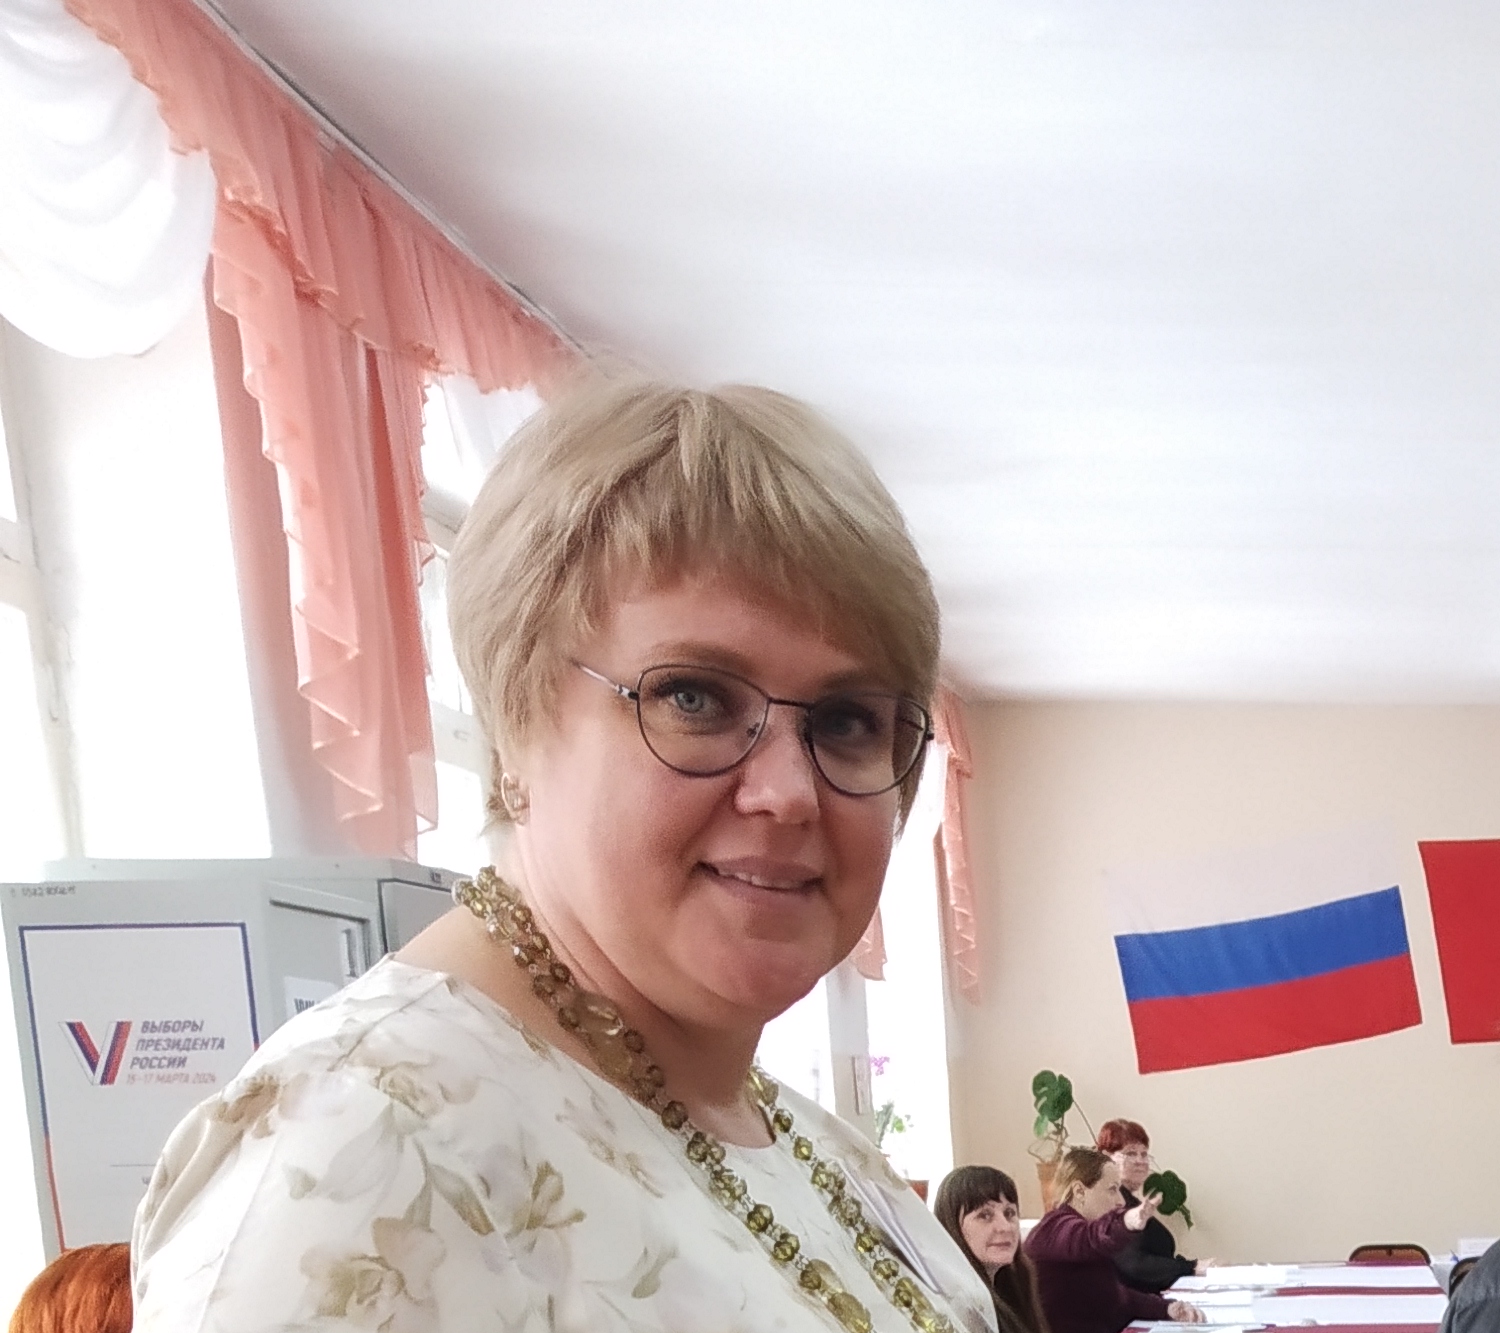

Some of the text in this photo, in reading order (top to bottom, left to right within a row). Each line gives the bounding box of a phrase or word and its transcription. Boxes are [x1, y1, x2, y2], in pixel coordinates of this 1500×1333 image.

[141, 1020, 204, 1034] ВЫБОРЫ
[136, 1037, 225, 1051] ПРЕЗИДЕНТА
[130, 1056, 187, 1070] РОССИИ
[156, 1073, 190, 1085] МАРТА
